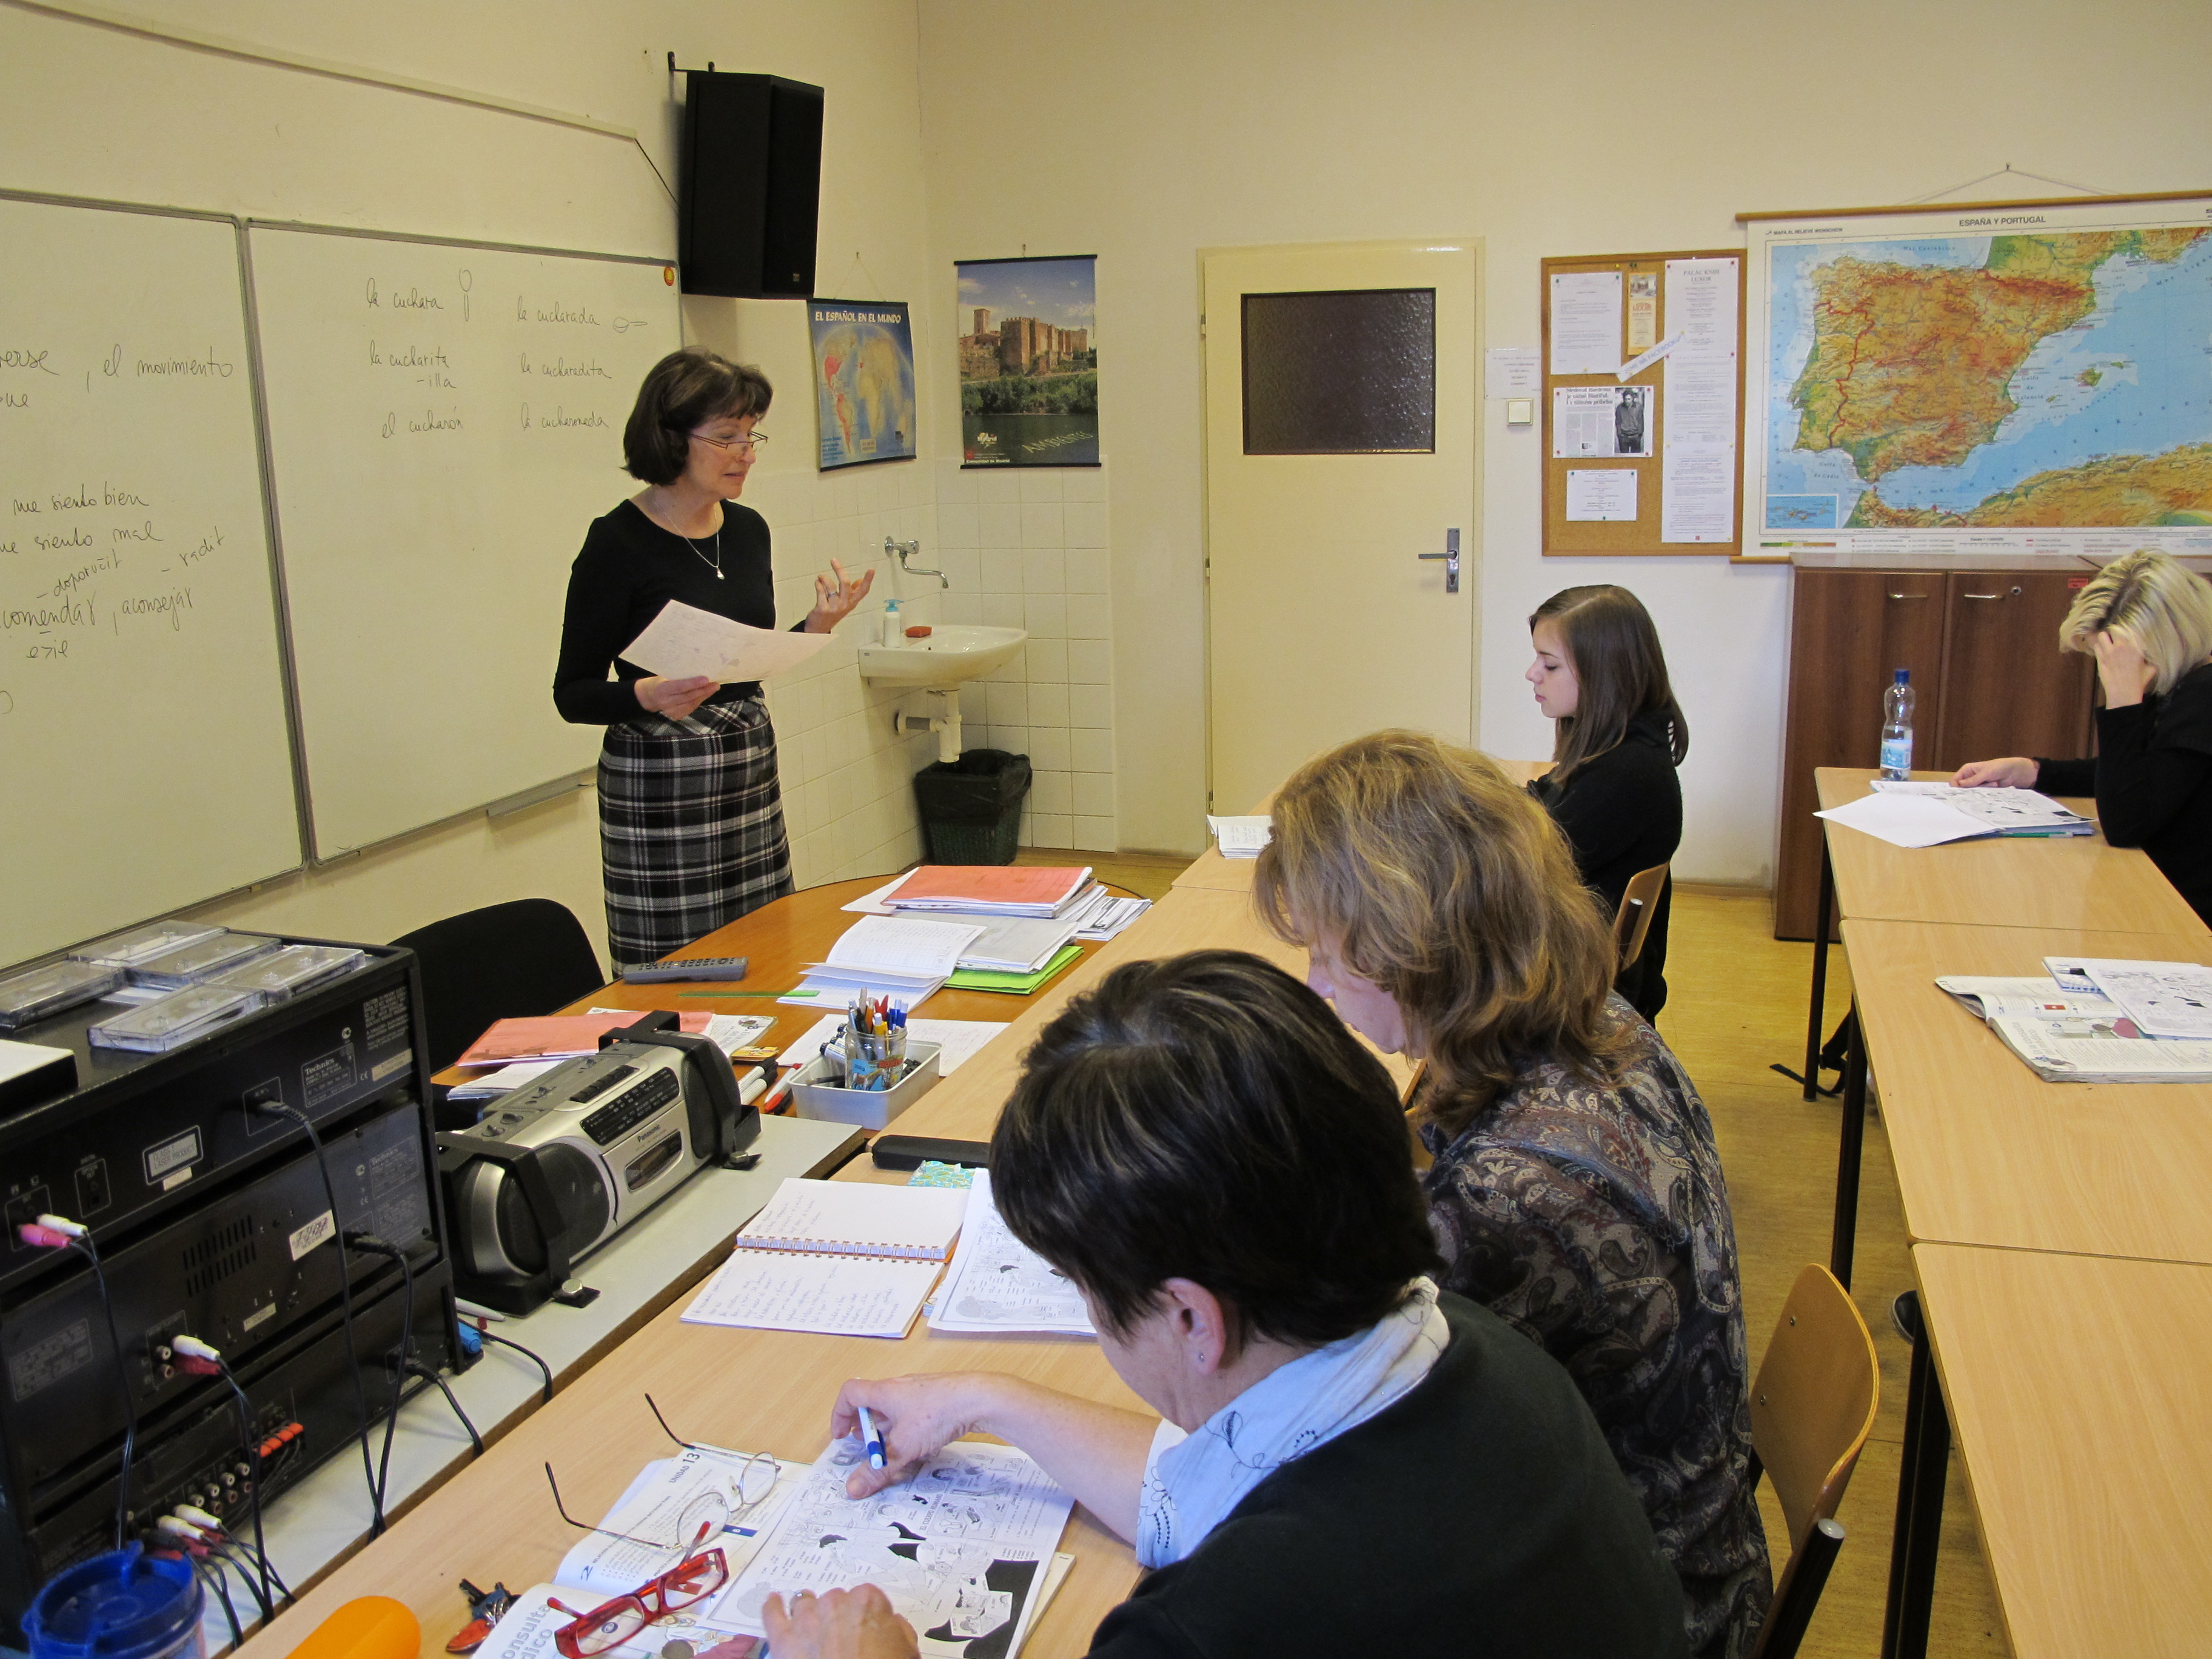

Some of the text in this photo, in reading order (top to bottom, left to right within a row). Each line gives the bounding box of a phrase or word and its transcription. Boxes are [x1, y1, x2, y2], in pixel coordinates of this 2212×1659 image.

[1959, 218, 1991, 226] ESPAÑA
[2001, 216, 2046, 224] PORTUGAL
[367, 277, 444, 310] la cuchara
[517, 295, 600, 326] la cucharada
[815, 310, 902, 324] EL ESPAÑOL EN EL MUNDO
[104, 344, 121, 378] el
[138, 346, 233, 377] movimiento
[370, 340, 449, 368] la cucharita
[521, 352, 612, 379] la cucharadita
[382, 406, 464, 438] el cucharón
[52, 483, 97, 511] siento
[104, 481, 150, 506] bien
[35, 527, 93, 551] siento
[113, 520, 164, 543] mal
[0, 587, 194, 631] comendar aconsejar
[306, 1058, 335, 1075] Technics
[638, 1124, 660, 1142] Panasonic
[668, 1452, 701, 1484] UNIDAD 13
[922, 1507, 936, 1524] CUERPO
[931, 1492, 944, 1509] HUMANO
[580, 1564, 594, 1582] 2
